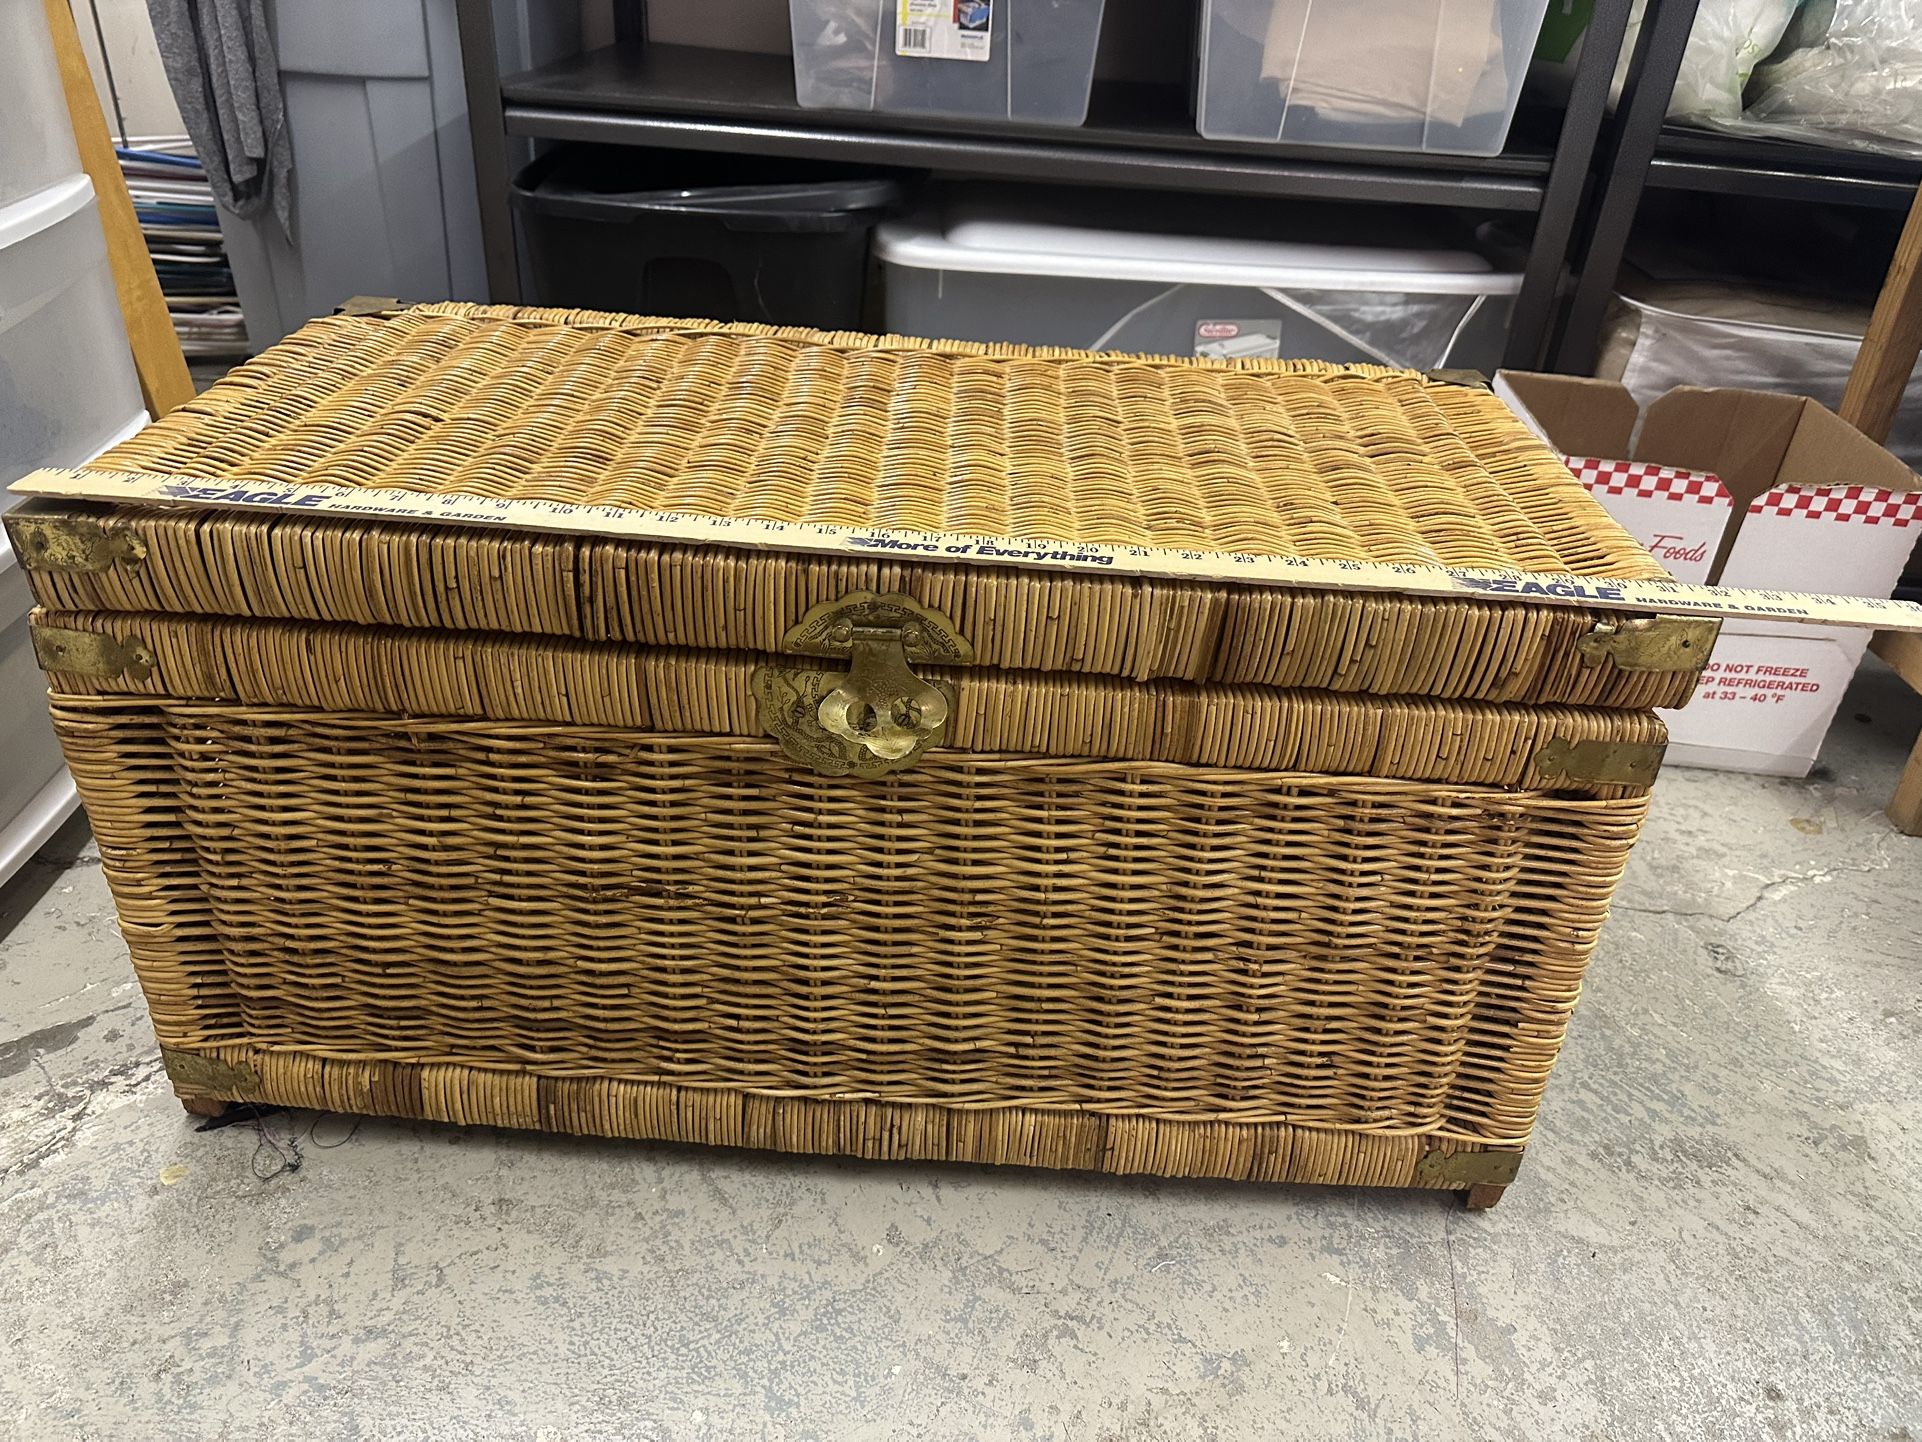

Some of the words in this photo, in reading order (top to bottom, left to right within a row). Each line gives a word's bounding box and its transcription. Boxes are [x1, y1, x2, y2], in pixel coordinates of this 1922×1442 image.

[180, 488, 333, 507] EAGLE
[328, 504, 419, 515] HARDWARE
[439, 512, 507, 522] GARDEN
[122, 476, 136, 484] 2
[604, 511, 624, 519] 11
[656, 515, 679, 523] 12
[709, 519, 732, 527] 13
[816, 527, 837, 535] 15
[869, 531, 891, 539] 16
[922, 535, 942, 543] 17
[974, 538, 995, 546] 18
[1026, 542, 1047, 550] 19
[1129, 549, 1150, 557] 21
[1181, 552, 1203, 560] 22
[1234, 556, 1255, 564] 23
[1285, 559, 1308, 567] 24
[1338, 563, 1361, 571] 25
[1392, 566, 1416, 574] 26
[1446, 570, 1467, 578] 27
[1498, 573, 1522, 582] 28
[1552, 577, 1575, 585] 29
[1604, 581, 1627, 589] 30
[1656, 585, 1680, 594] 31
[1708, 589, 1731, 598] 32
[1760, 593, 1783, 601] 33
[868, 539, 939, 552] More
[945, 544, 973, 554] of
[976, 545, 1114, 565] Everything
[1648, 534, 1706, 562] Foods
[1489, 579, 1626, 601] EAGLE
[1635, 597, 1723, 609] HARDWARE
[1743, 605, 1809, 615] GARDEN
[1724, 663, 1753, 674] NOT
[1755, 665, 1810, 678] FREEZE
[1697, 676, 1715, 685] EP
[1717, 677, 1820, 692] REFRIGERATED
[1703, 691, 1717, 699] at
[1719, 691, 1737, 700] 33
[1750, 693, 1767, 703] 40
